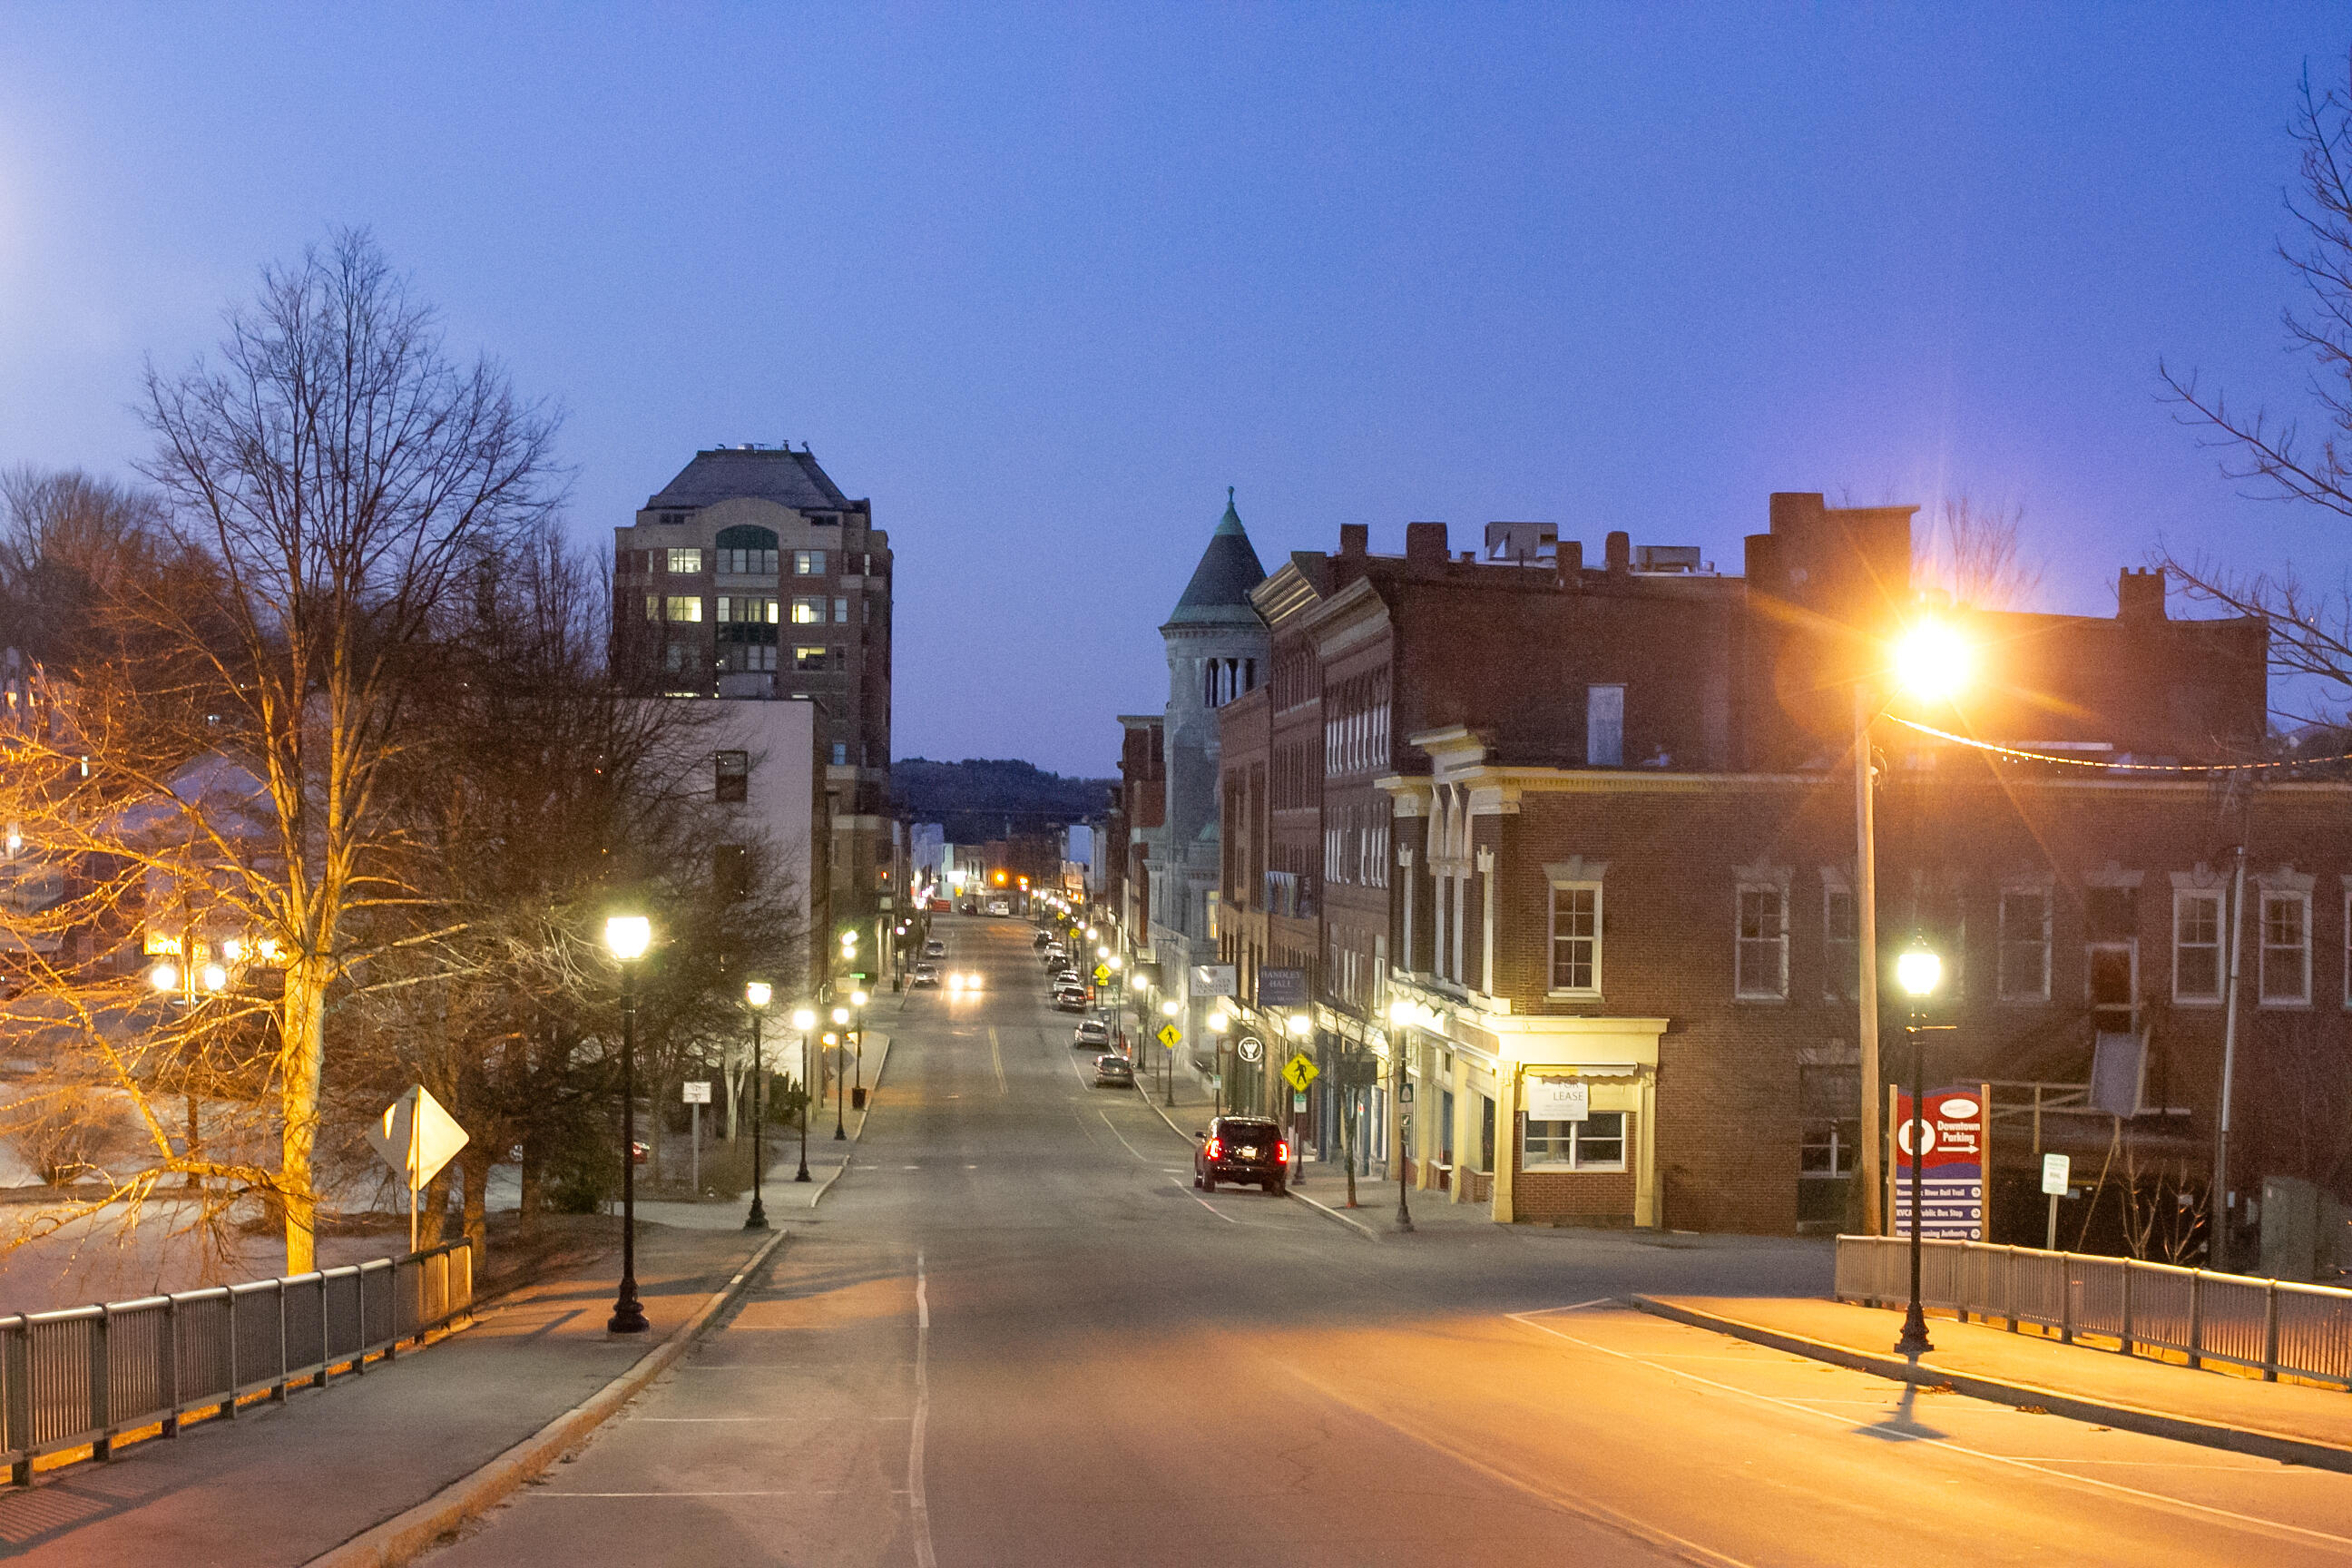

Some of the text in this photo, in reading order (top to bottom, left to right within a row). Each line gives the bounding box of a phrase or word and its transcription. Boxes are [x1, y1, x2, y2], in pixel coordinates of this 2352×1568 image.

[1261, 970, 1300, 979] HANDLEY
[1269, 980, 1292, 988] HALL
[1558, 1078, 1579, 1089] FOR
[1553, 1092, 1583, 1102] LEASE
[1937, 1121, 1980, 1132] Downtown
[1944, 1132, 1975, 1145] Parking
[1920, 1209, 1936, 1217] ublic
[1937, 1209, 1949, 1217] Bus
[1949, 1209, 1964, 1219] Stop
[1920, 1230, 1940, 1239] ousing
[1941, 1230, 1968, 1239] Authority
